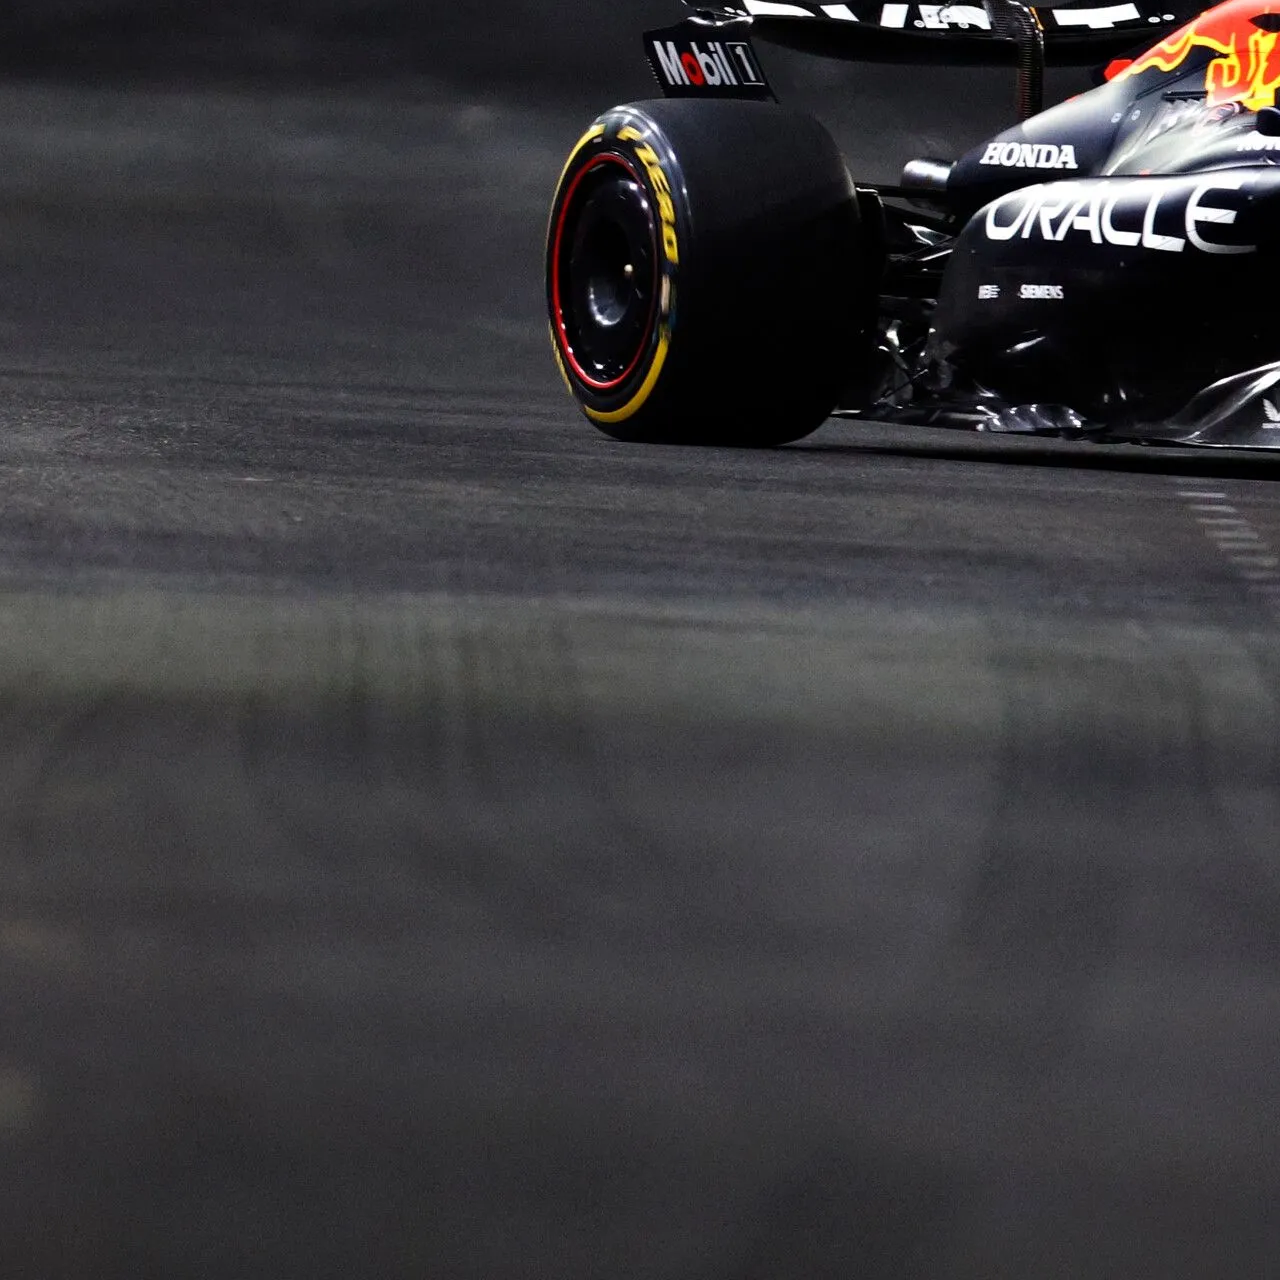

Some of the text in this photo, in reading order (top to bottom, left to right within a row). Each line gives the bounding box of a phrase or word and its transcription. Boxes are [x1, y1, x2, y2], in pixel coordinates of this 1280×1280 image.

[658, 40, 759, 87] Mobil 1
[979, 141, 1079, 170] HONDA
[634, 139, 680, 265] ZERO
[984, 172, 1262, 255] ORACLE
